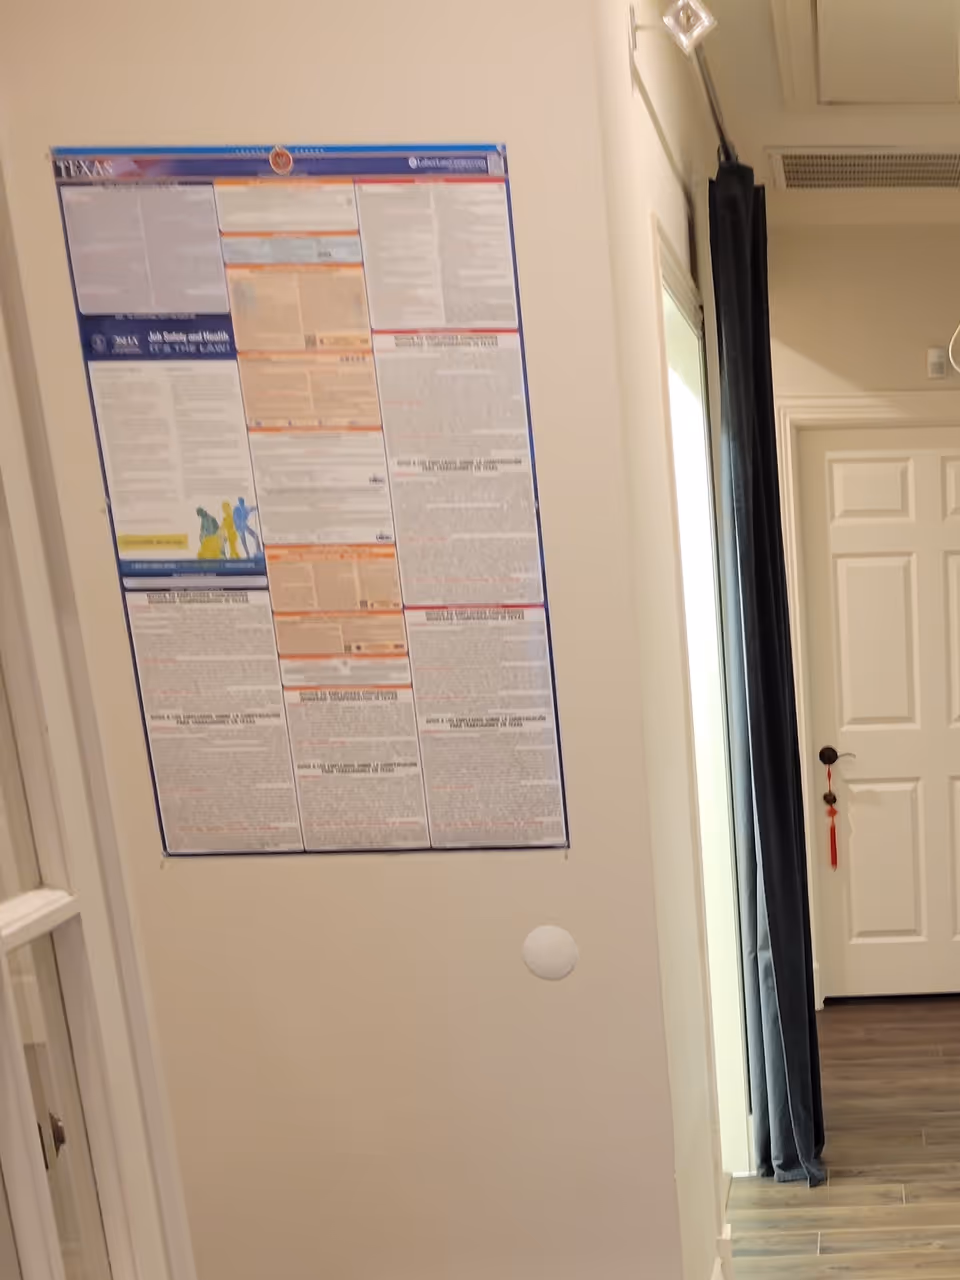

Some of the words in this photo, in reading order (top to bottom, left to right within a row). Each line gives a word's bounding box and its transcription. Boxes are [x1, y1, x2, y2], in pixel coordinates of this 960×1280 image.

[56, 160, 112, 178] TEXAS
[148, 331, 162, 343] Job
[163, 331, 187, 346] Safety
[188, 331, 203, 343] and
[203, 331, 230, 343] Health
